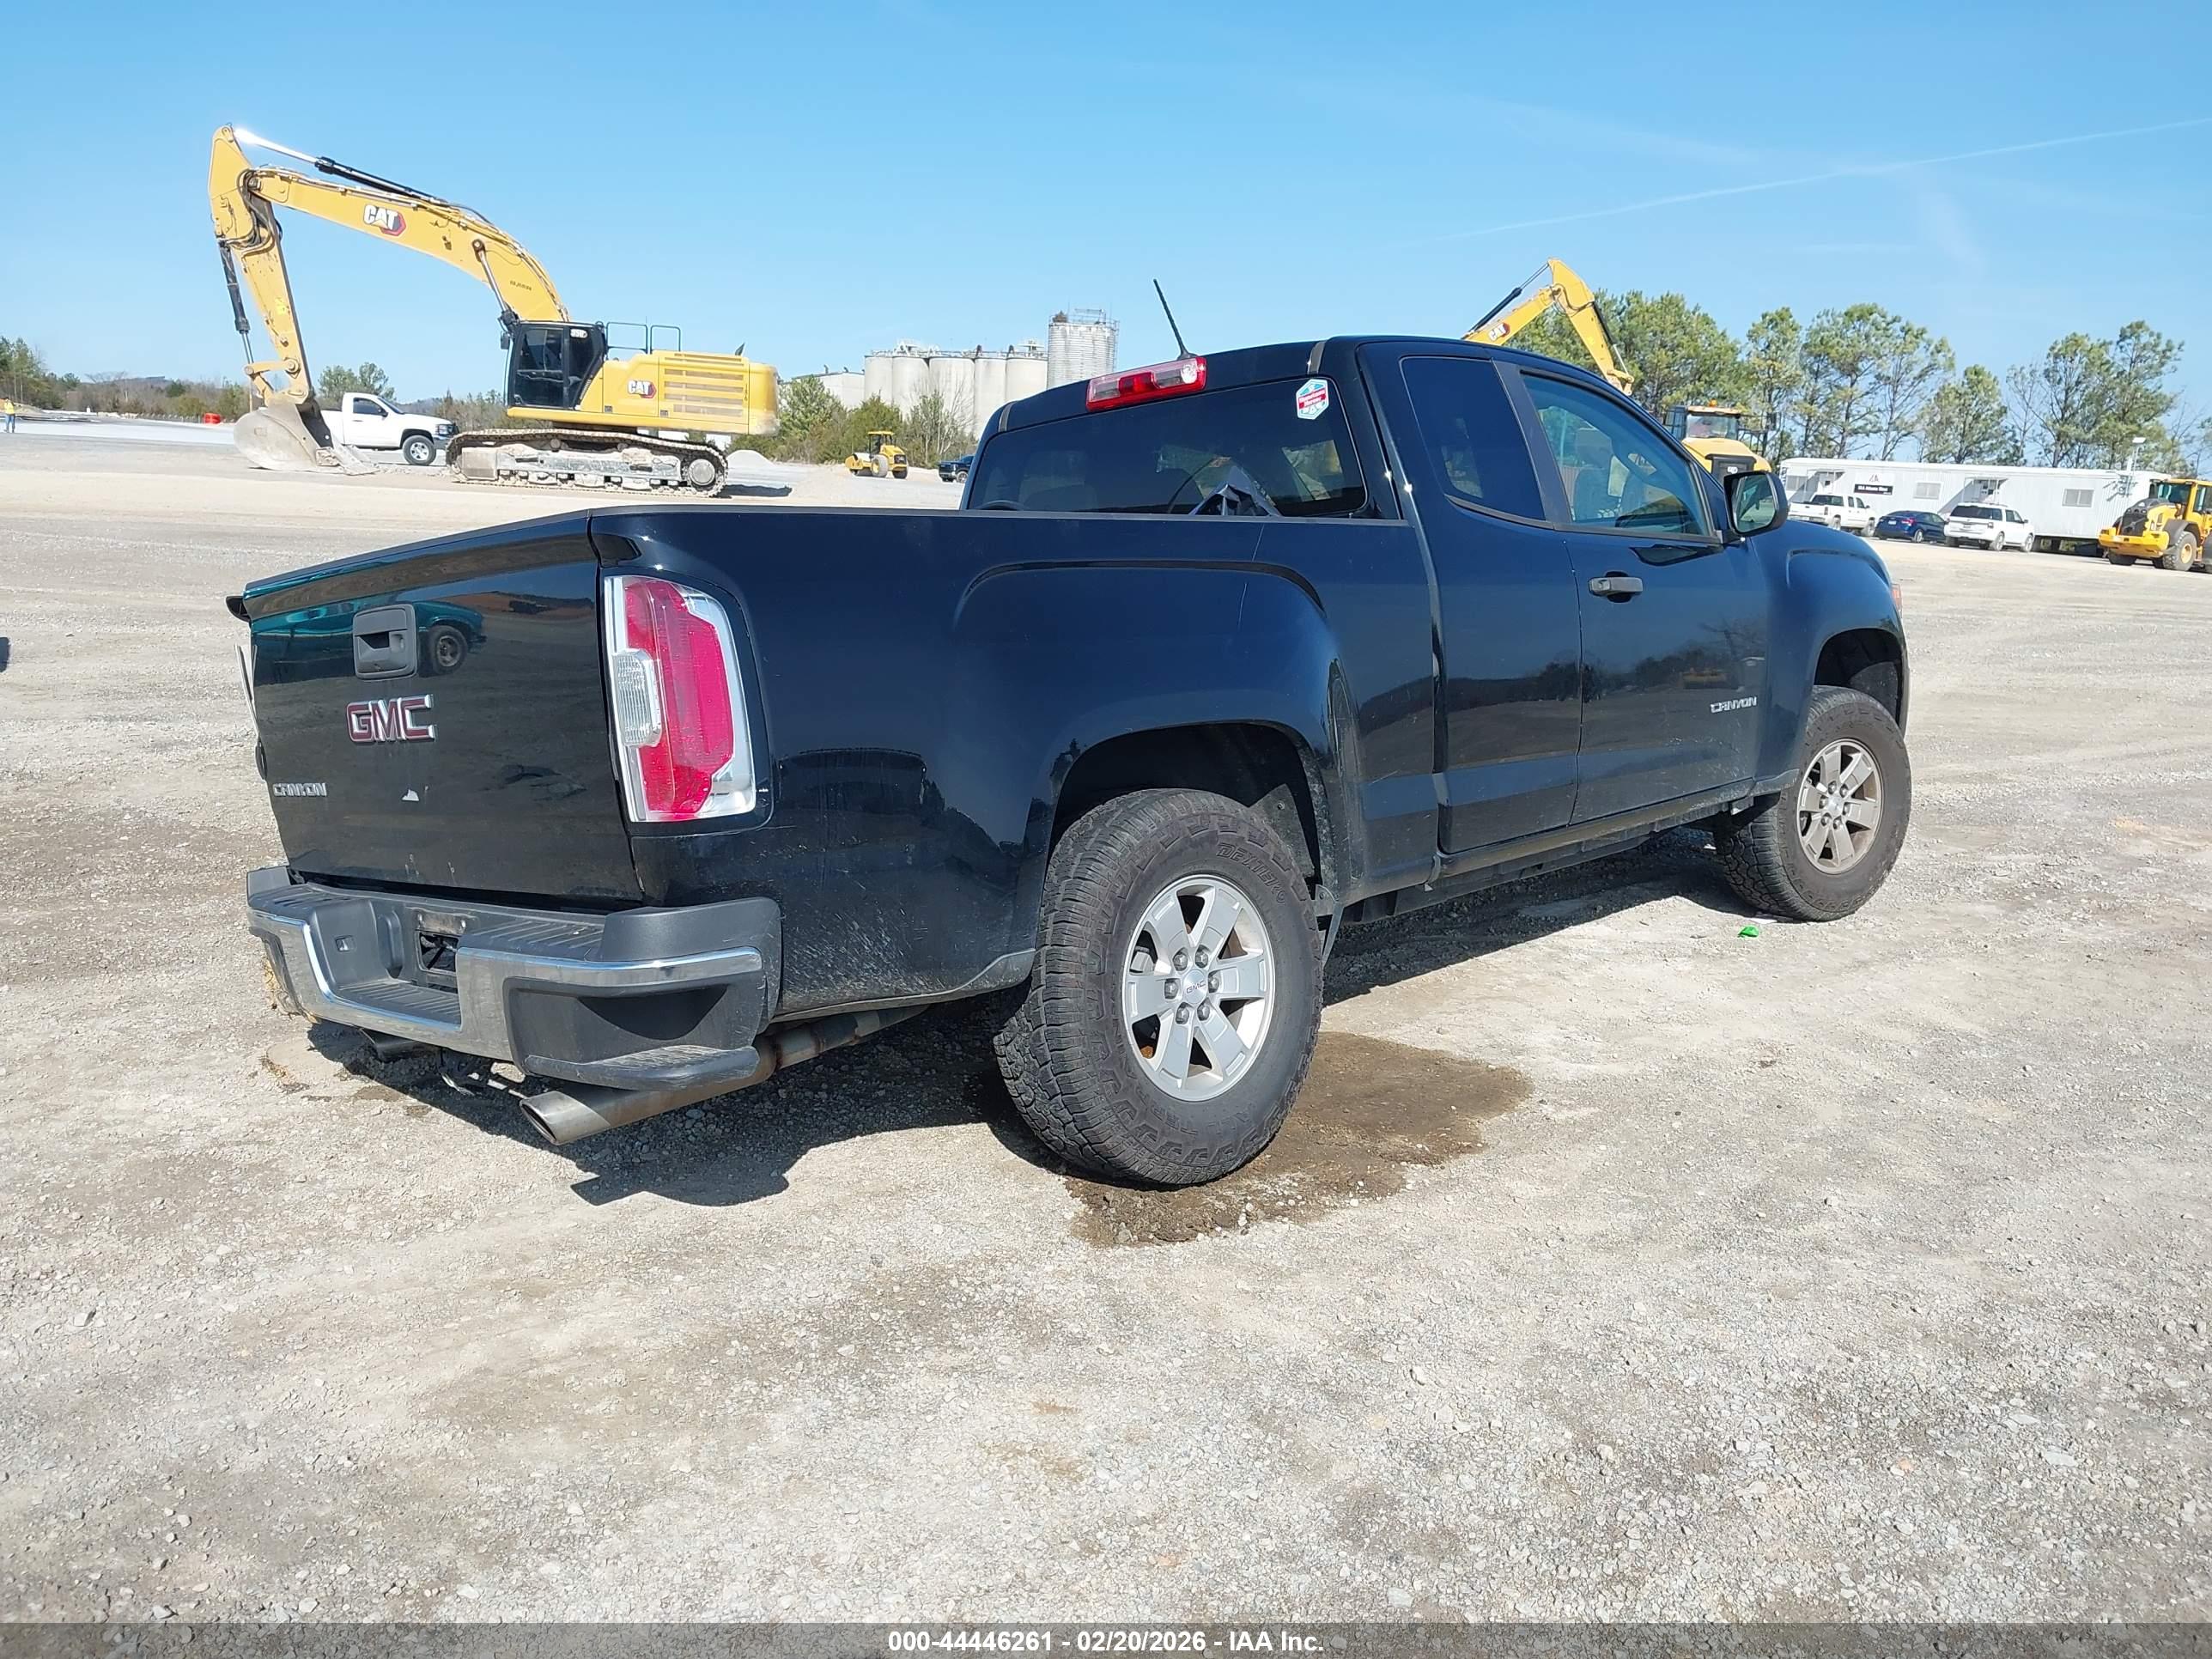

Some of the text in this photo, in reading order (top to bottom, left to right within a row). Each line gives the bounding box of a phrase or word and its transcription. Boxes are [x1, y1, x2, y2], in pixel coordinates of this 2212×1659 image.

[363, 204, 398, 230] CAT
[628, 380, 652, 396] CAT
[1710, 696, 1758, 714] CANYON
[346, 694, 437, 743] GMC
[272, 782, 327, 797] CANYON
[1186, 980, 1206, 994] GMC
